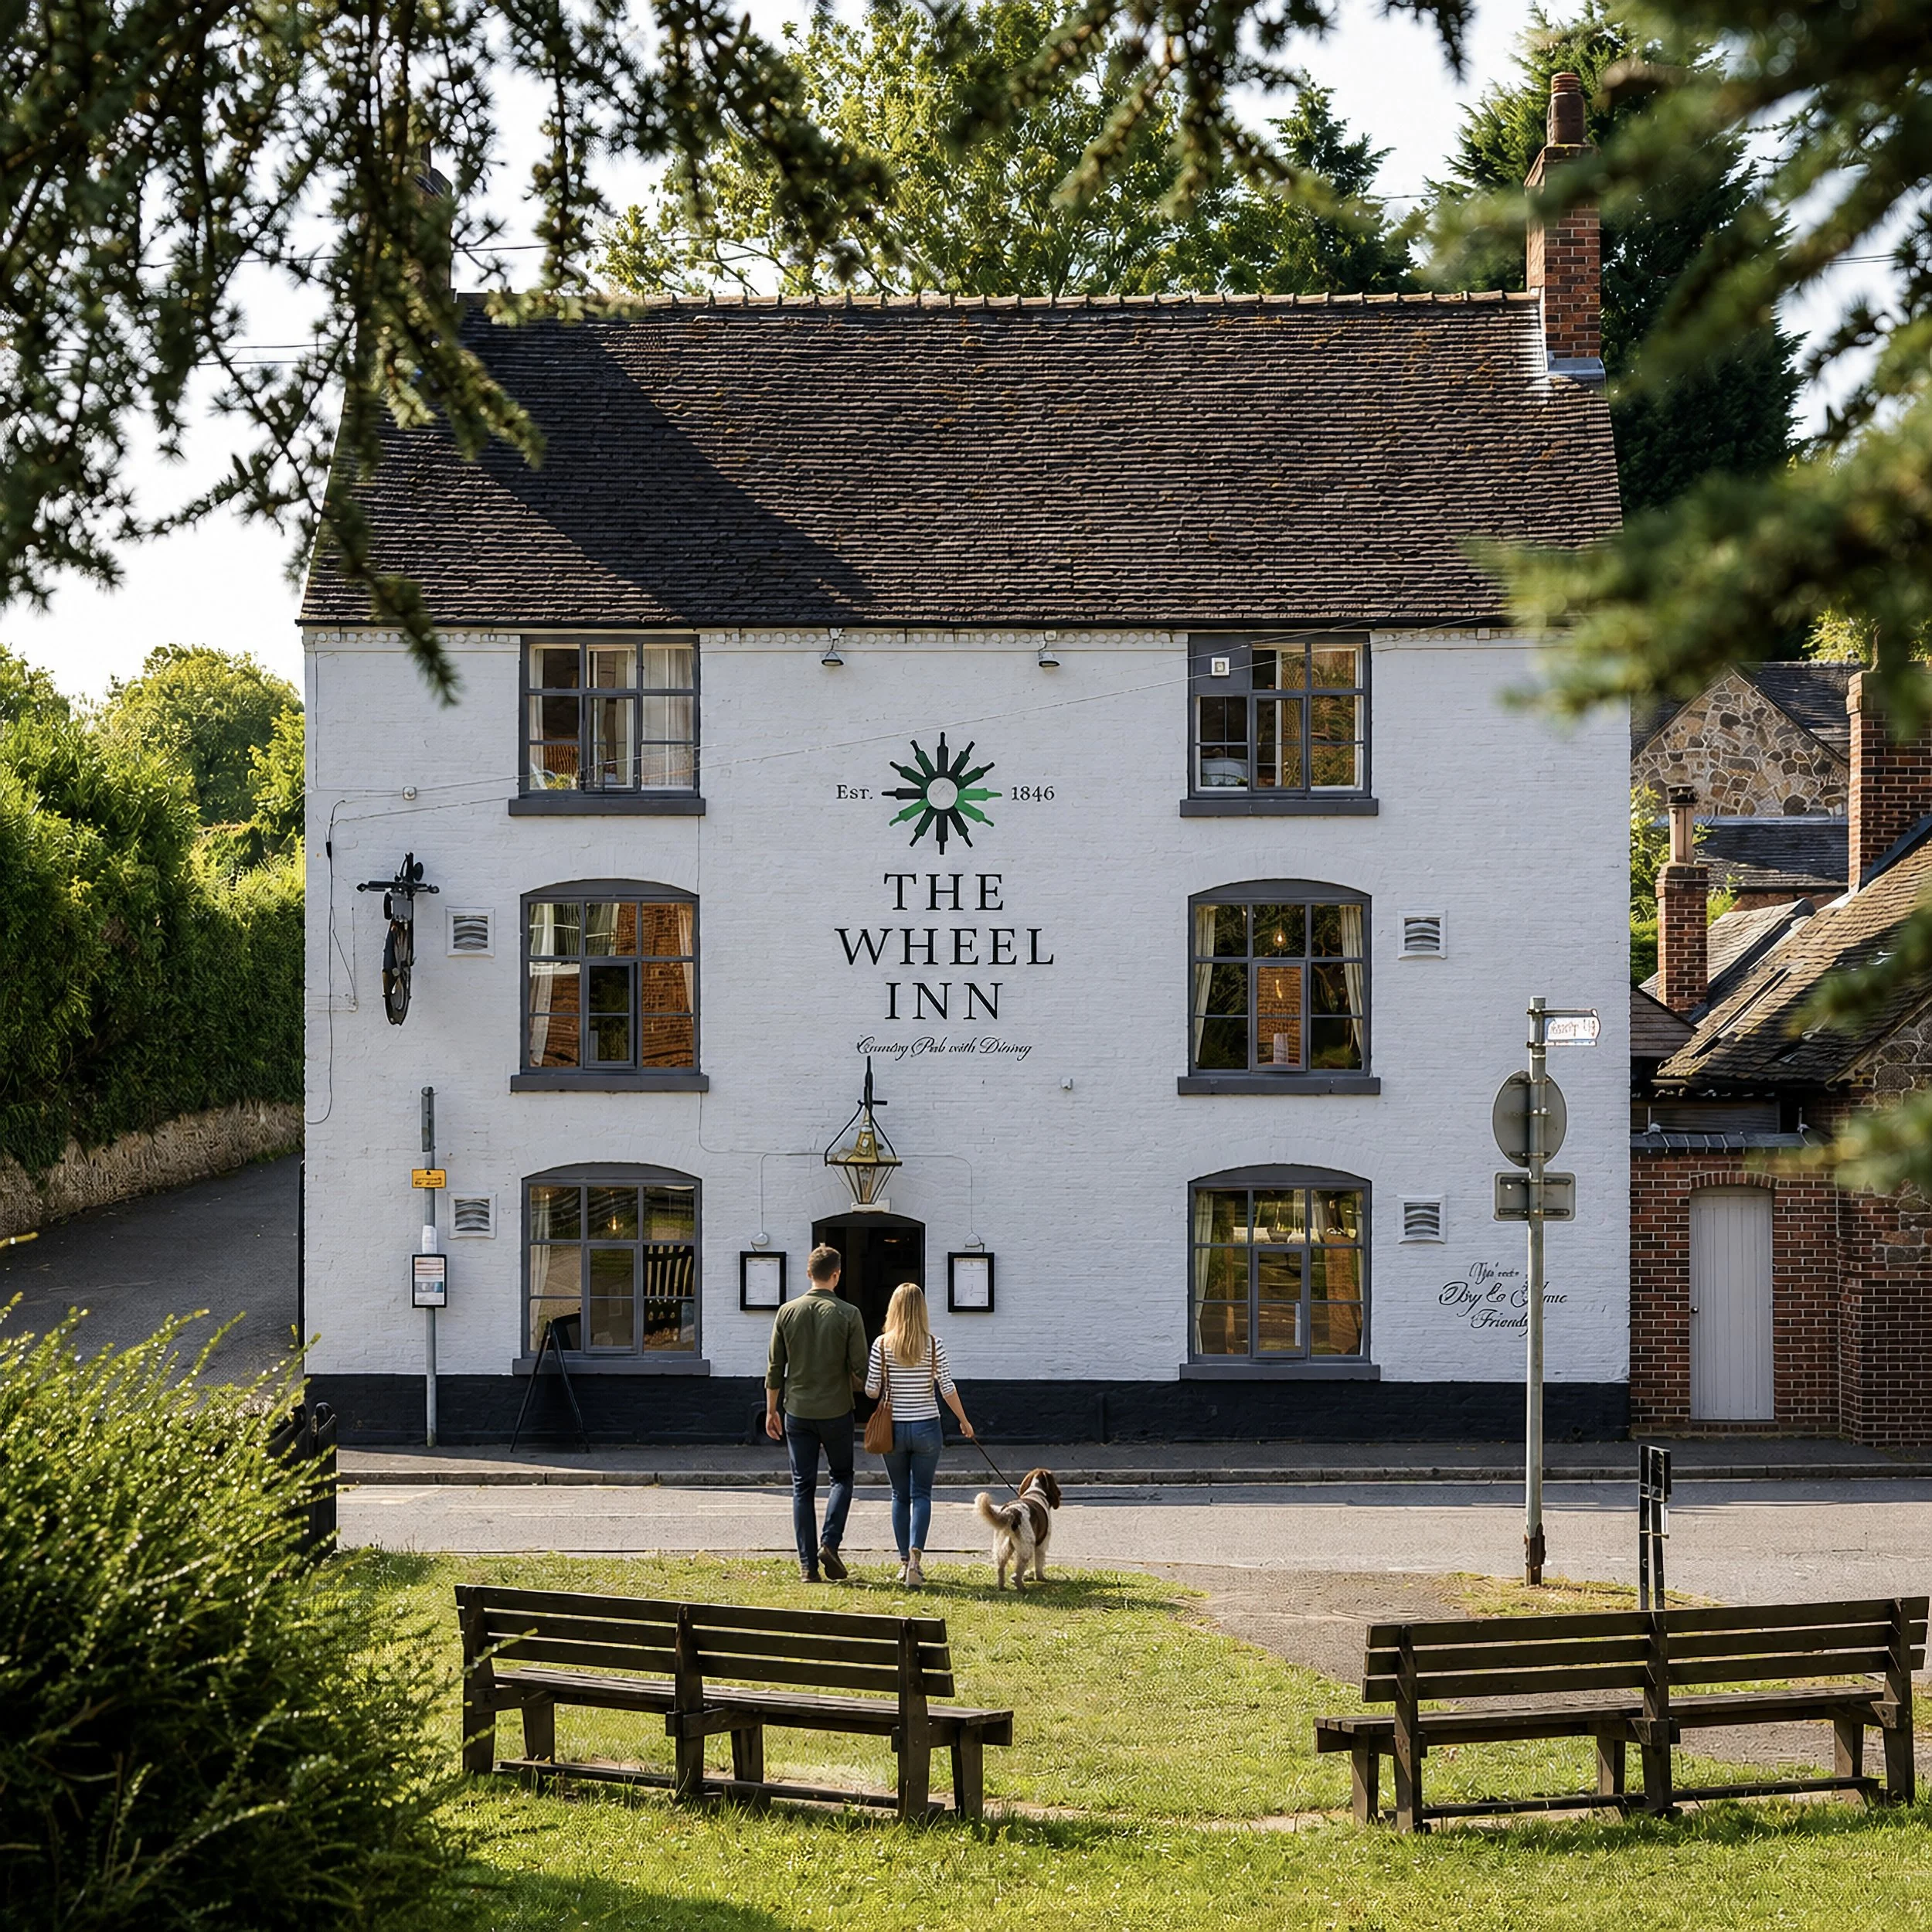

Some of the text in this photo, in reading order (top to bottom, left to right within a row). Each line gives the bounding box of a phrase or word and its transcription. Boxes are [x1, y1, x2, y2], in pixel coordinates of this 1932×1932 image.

[1012, 785, 1055, 802] 1846
[883, 872, 1004, 911] THE
[834, 927, 1055, 966] WHEEL
[884, 982, 1004, 1020] INN
